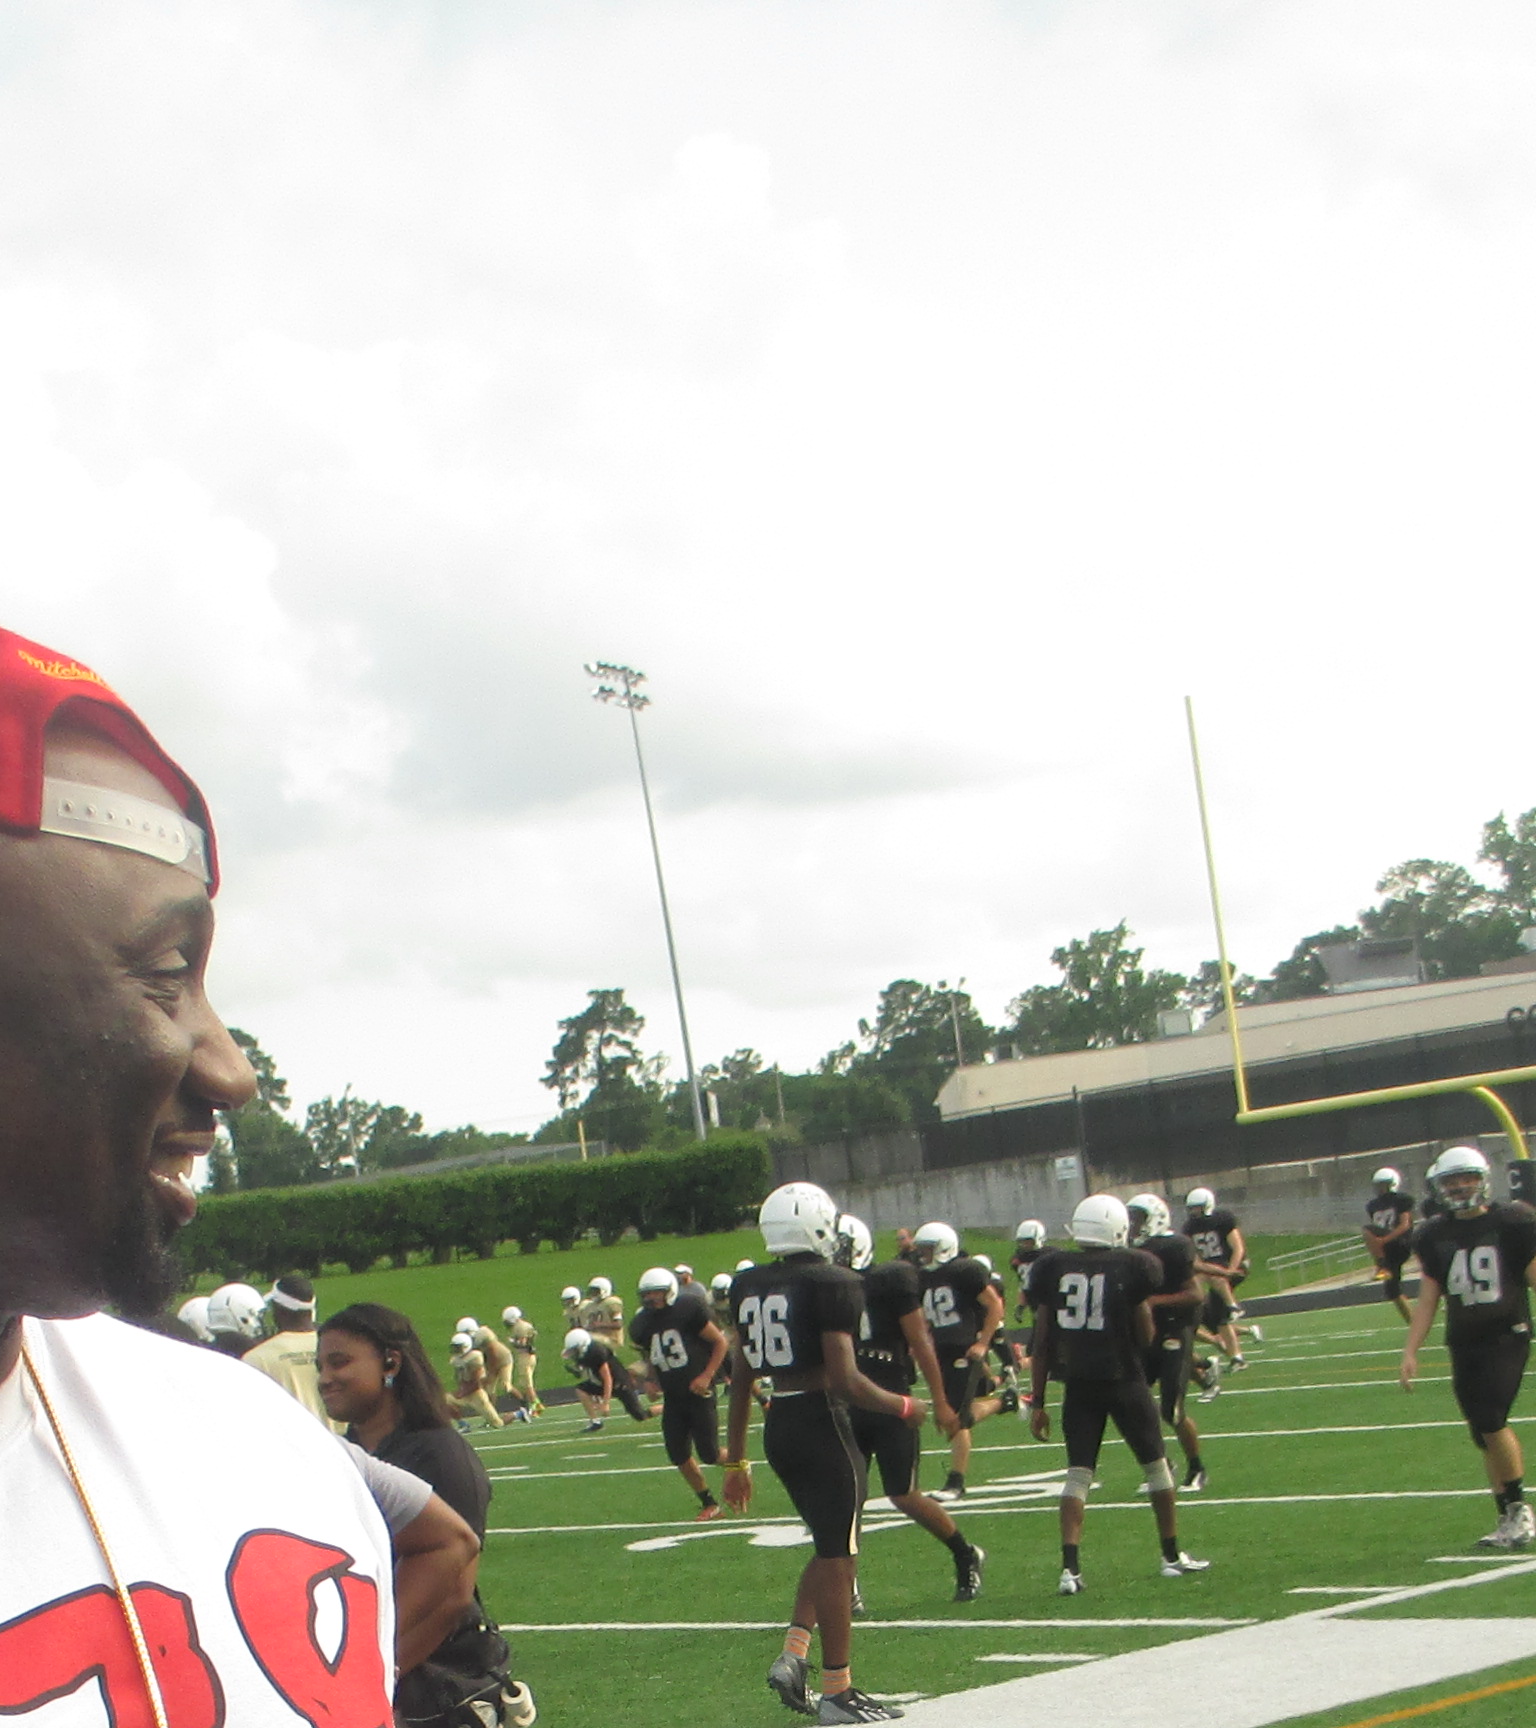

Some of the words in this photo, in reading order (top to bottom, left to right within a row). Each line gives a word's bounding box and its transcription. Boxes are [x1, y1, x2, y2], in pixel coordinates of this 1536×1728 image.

[1056, 1272, 1106, 1331] 31
[1446, 1245, 1503, 1307] 49
[738, 1294, 794, 1370] 36
[922, 1285, 962, 1328] 42
[650, 1328, 689, 1373] 43
